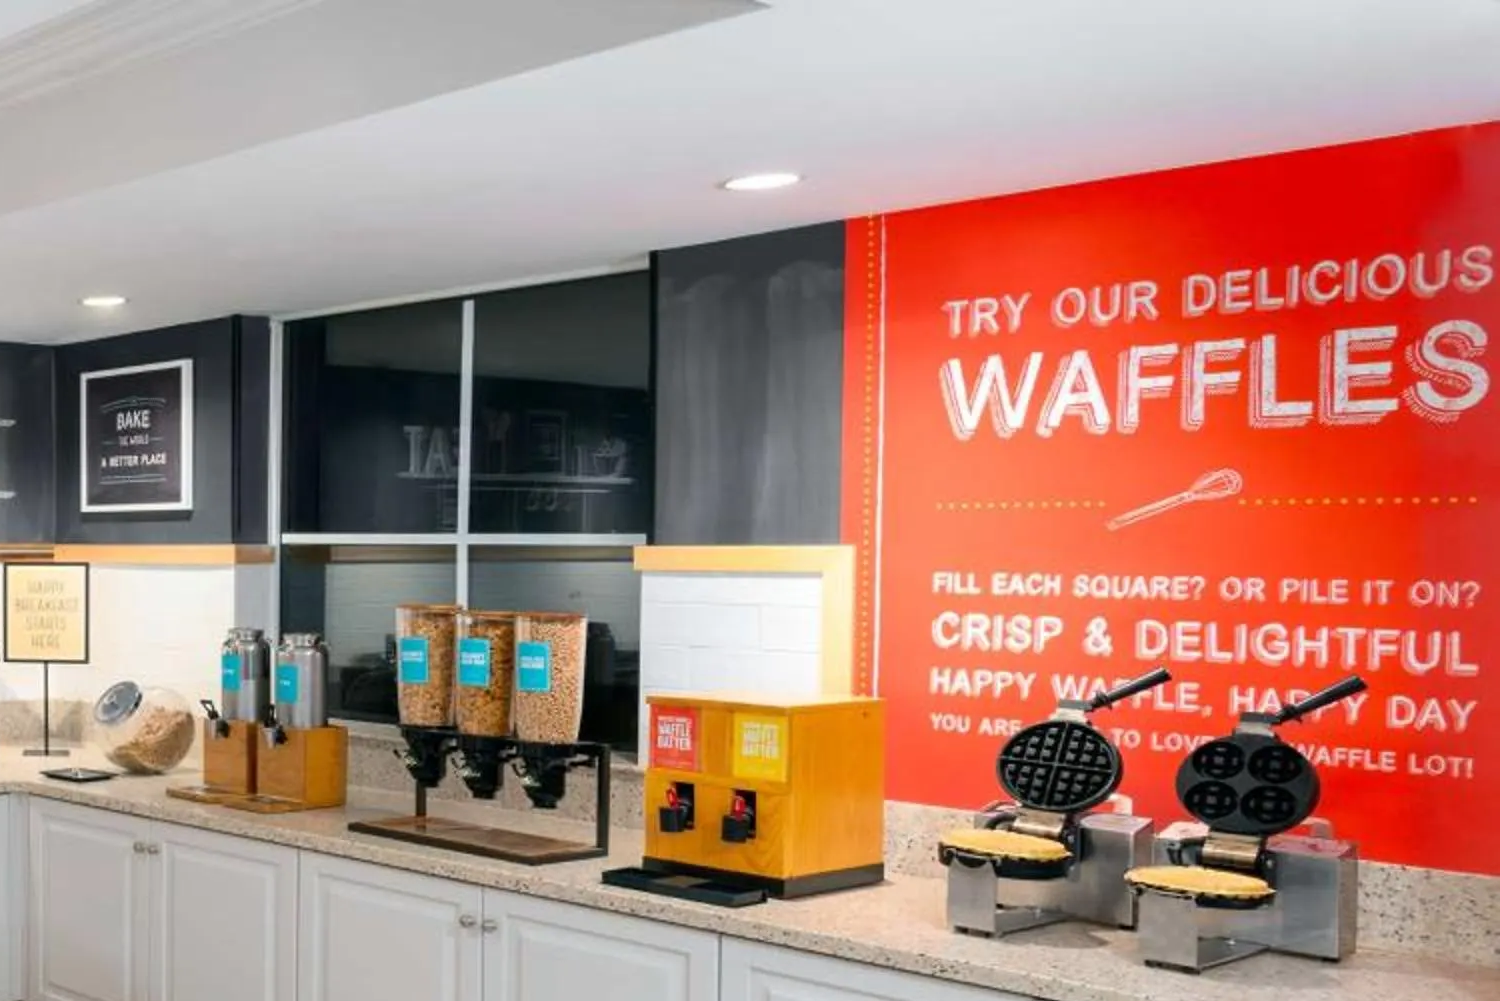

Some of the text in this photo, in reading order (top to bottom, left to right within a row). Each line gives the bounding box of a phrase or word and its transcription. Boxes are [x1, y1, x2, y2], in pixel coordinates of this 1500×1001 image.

[941, 245, 1493, 339] TRY OUR DELICIOUS
[938, 319, 1491, 441] WAFFLES
[116, 409, 150, 431] BAKE
[101, 457, 107, 468] A
[932, 571, 1481, 608] FILL EACH SQUARE? OR PILE IT ON?
[931, 610, 1480, 677] CRISP & DELIGHTFUL
[929, 666, 1037, 700] HAPPY
[1228, 684, 1370, 725] HAPY
[1386, 694, 1478, 732] DAY
[929, 711, 971, 733] YOU
[1108, 727, 1142, 749] TO
[1407, 753, 1474, 779] LOT!
